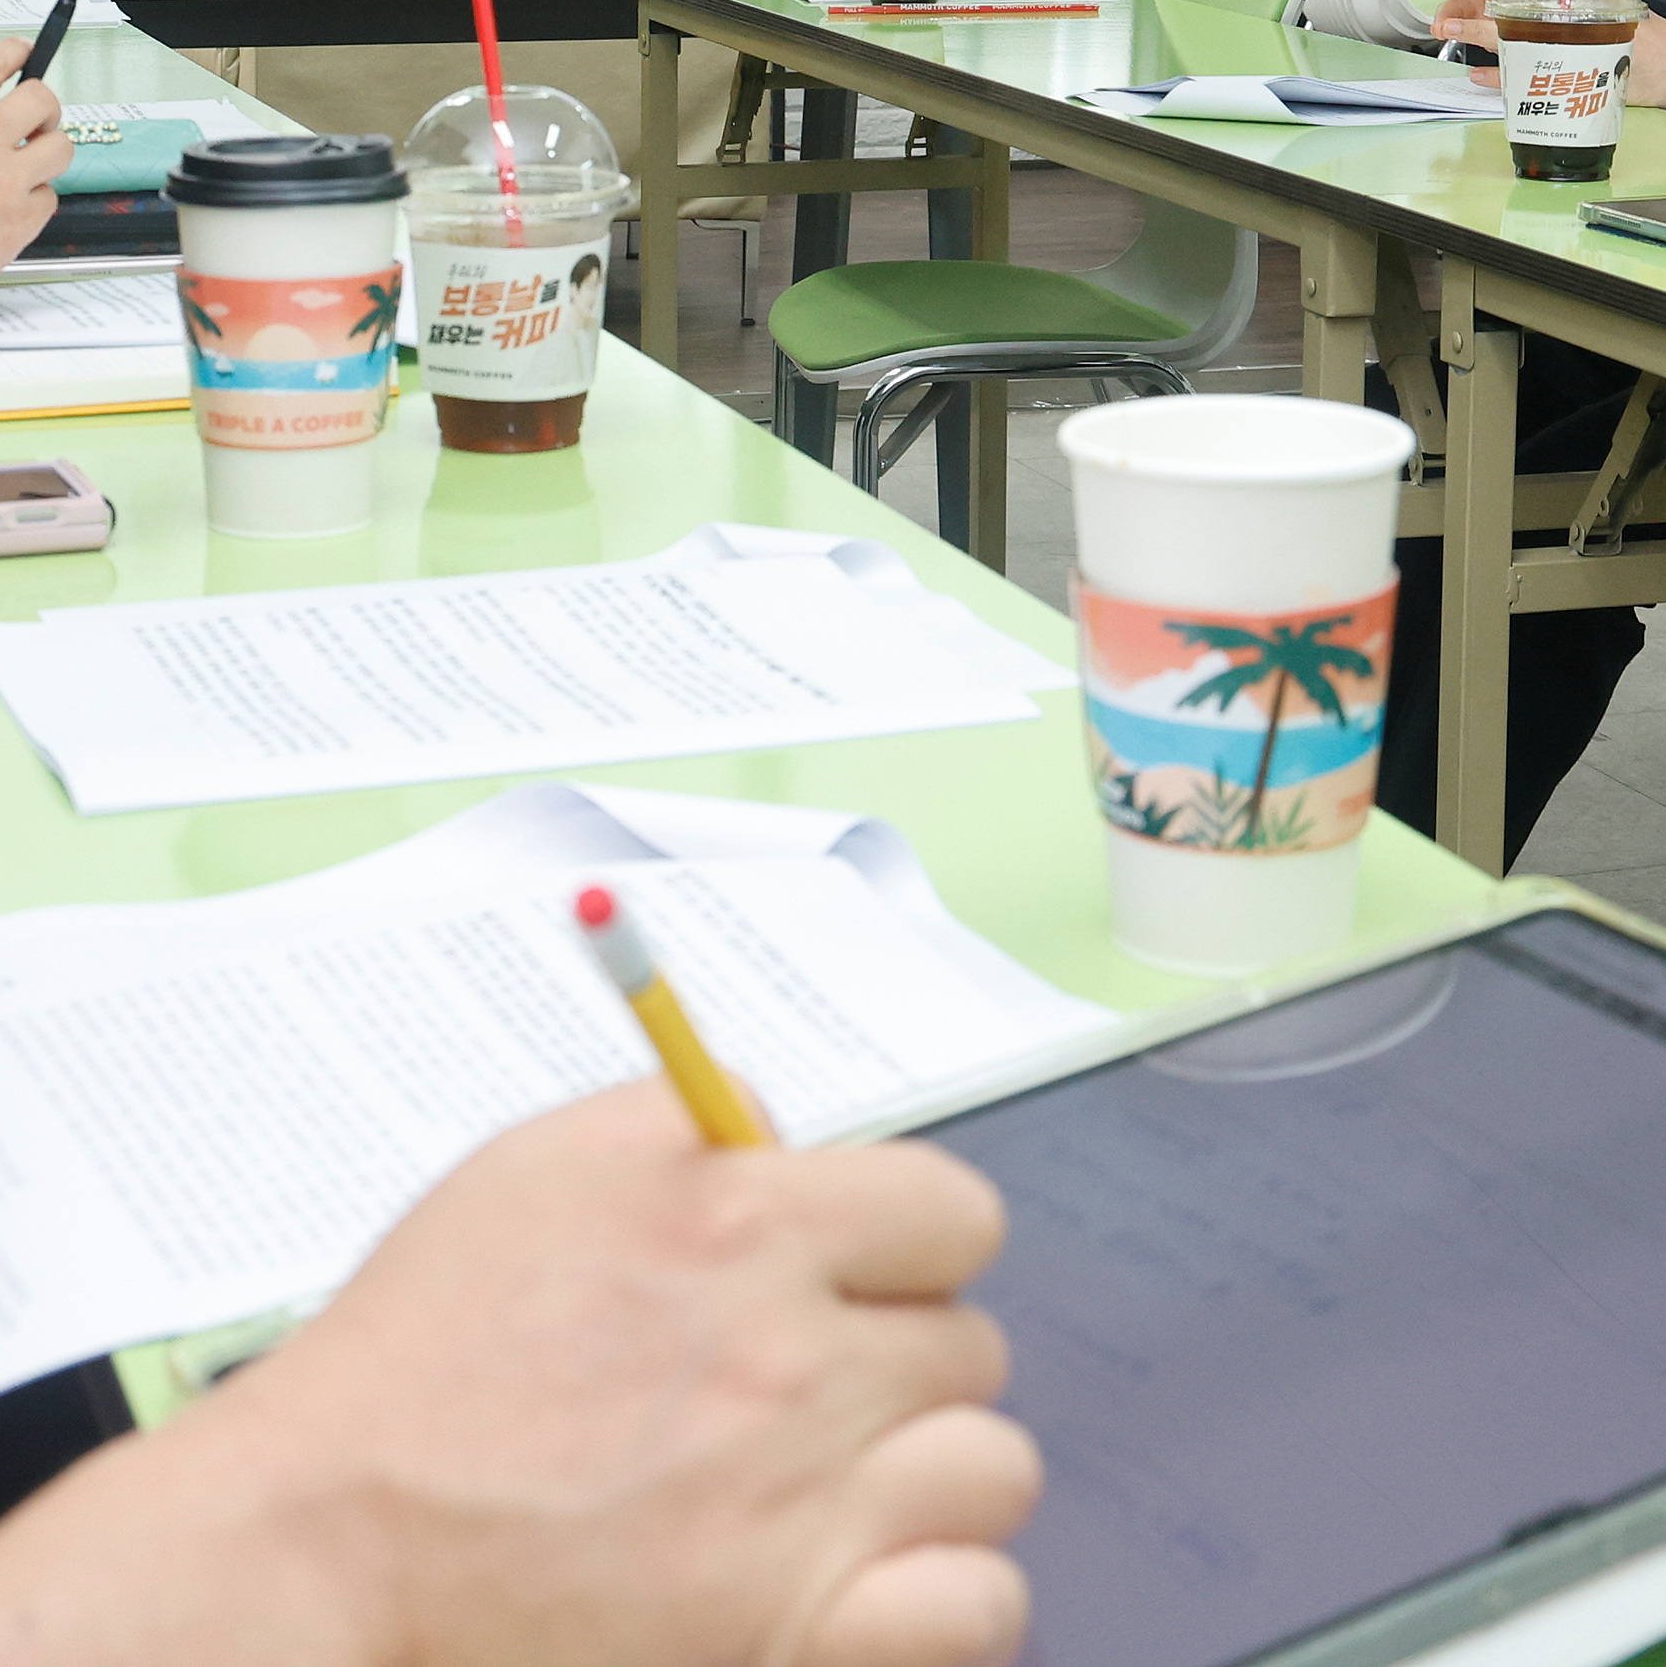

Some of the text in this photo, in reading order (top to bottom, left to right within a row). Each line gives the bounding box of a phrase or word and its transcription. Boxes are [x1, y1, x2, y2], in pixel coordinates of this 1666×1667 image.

[1534, 60, 1564, 74] 우리의
[1527, 67, 1610, 97] 보통날을
[1517, 89, 1609, 119] 채우는 커피
[1516, 128, 1548, 137] MAMMOTH
[491, 306, 561, 351] 커피
[207, 410, 365, 434] TRIPLE A COFFEE
